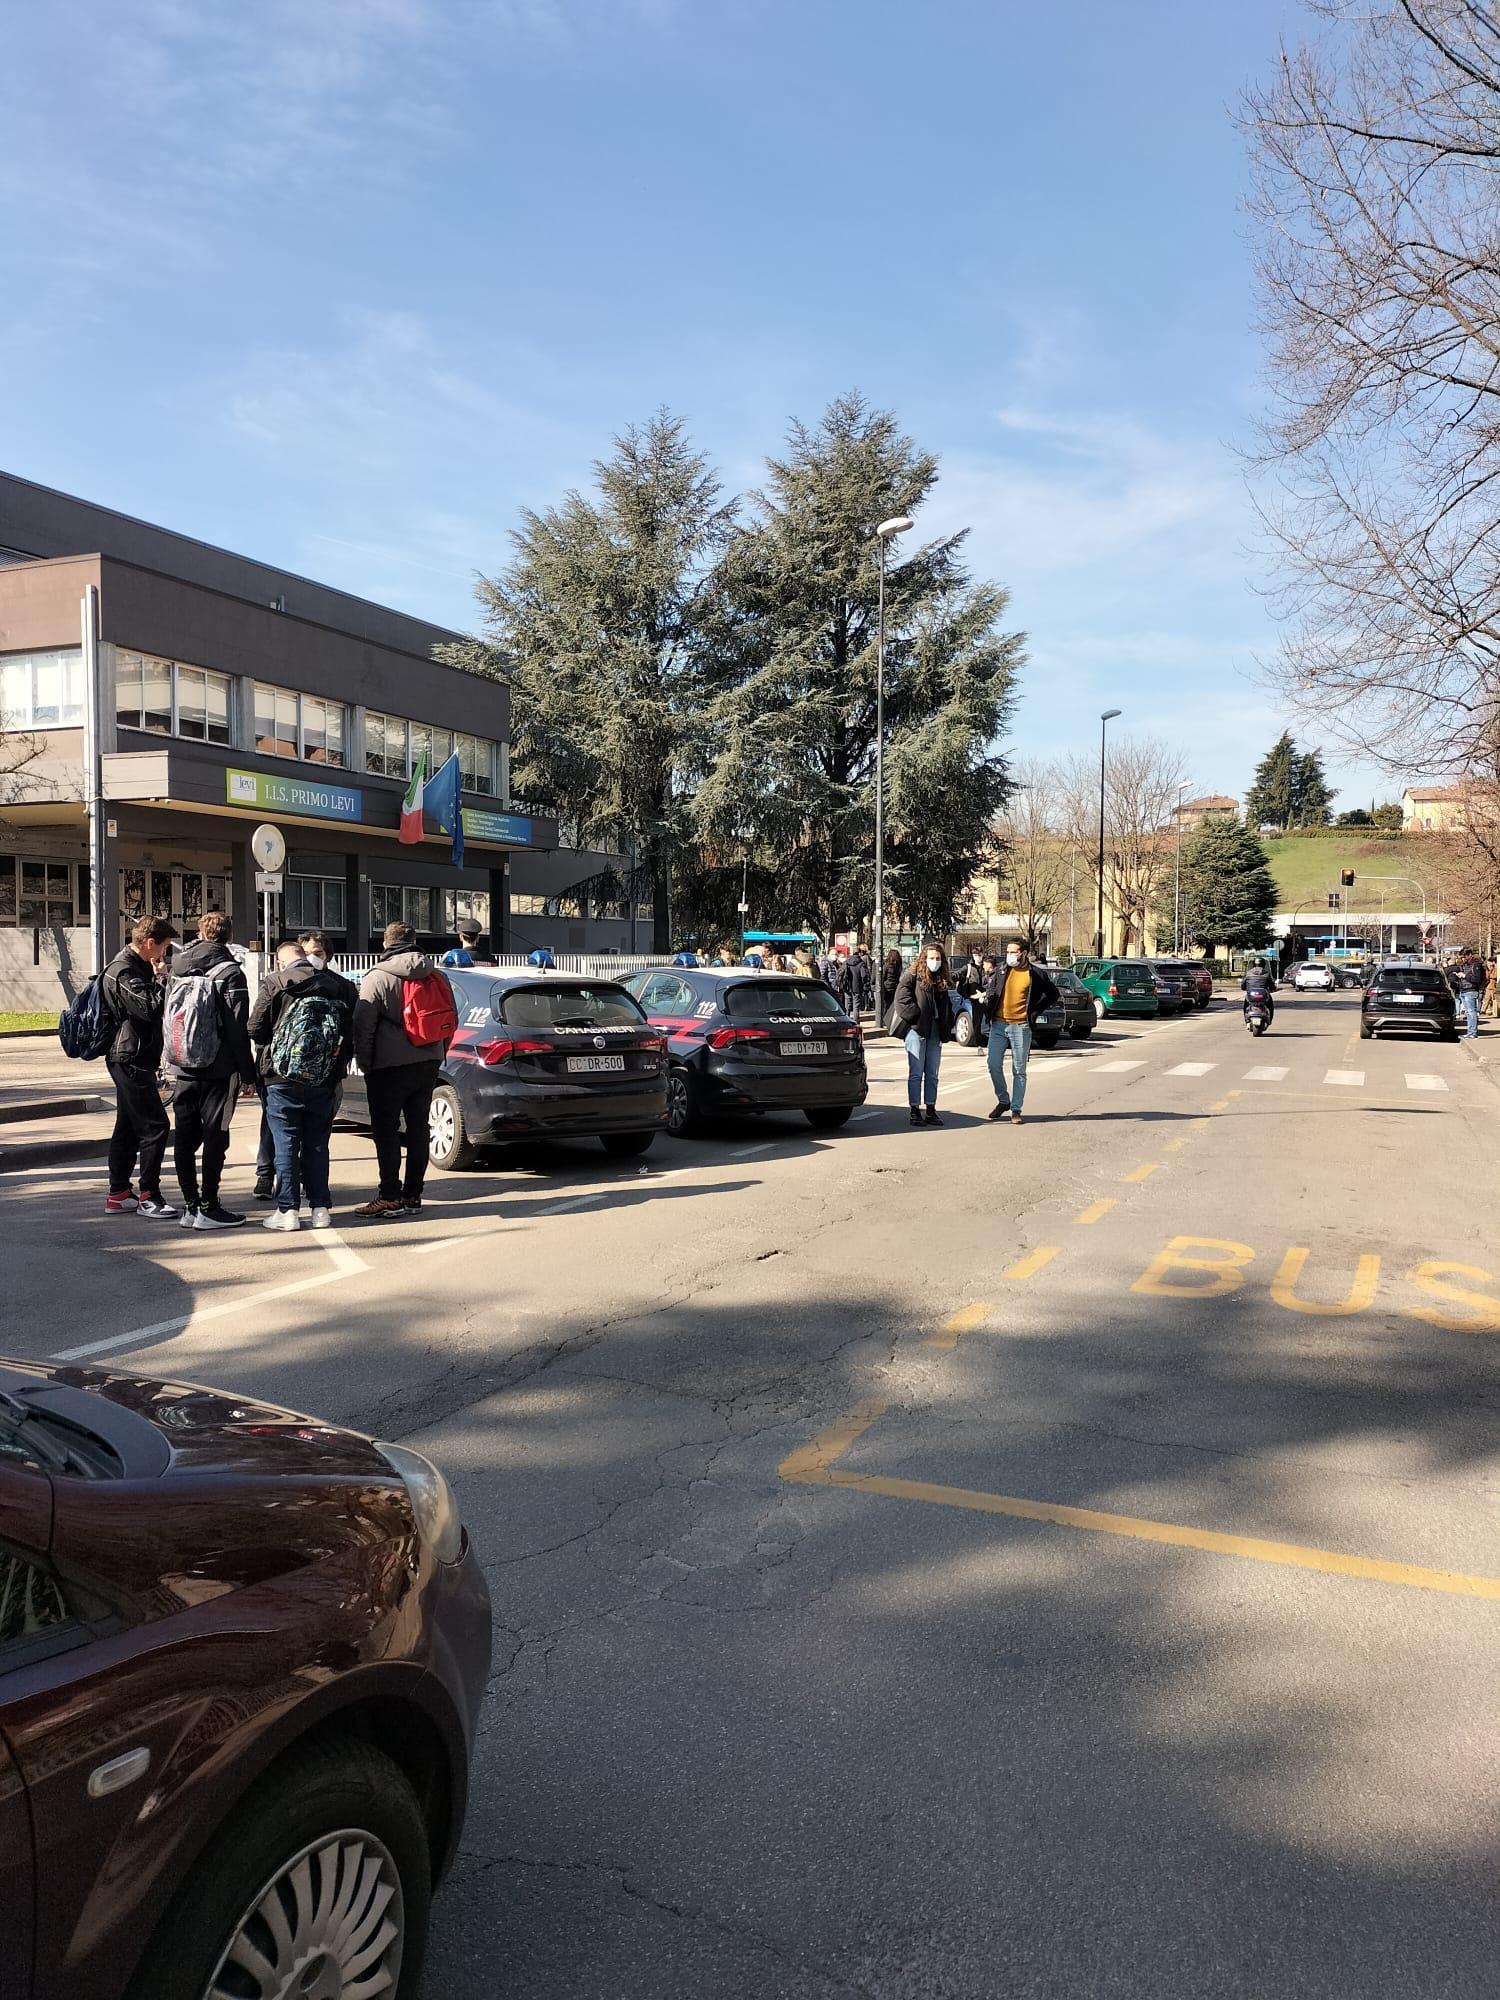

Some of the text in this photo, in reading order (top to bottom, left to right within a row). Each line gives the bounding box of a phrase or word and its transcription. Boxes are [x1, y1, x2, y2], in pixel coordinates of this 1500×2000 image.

[265, 784, 355, 812] I.I.S. PRIMO LEVI
[466, 1006, 491, 1024] 112
[697, 1001, 717, 1016] 112
[769, 1016, 838, 1024] CARABINIERI
[554, 1025, 636, 1035] CARABINIERI
[1128, 1235, 1500, 1334] BUS
